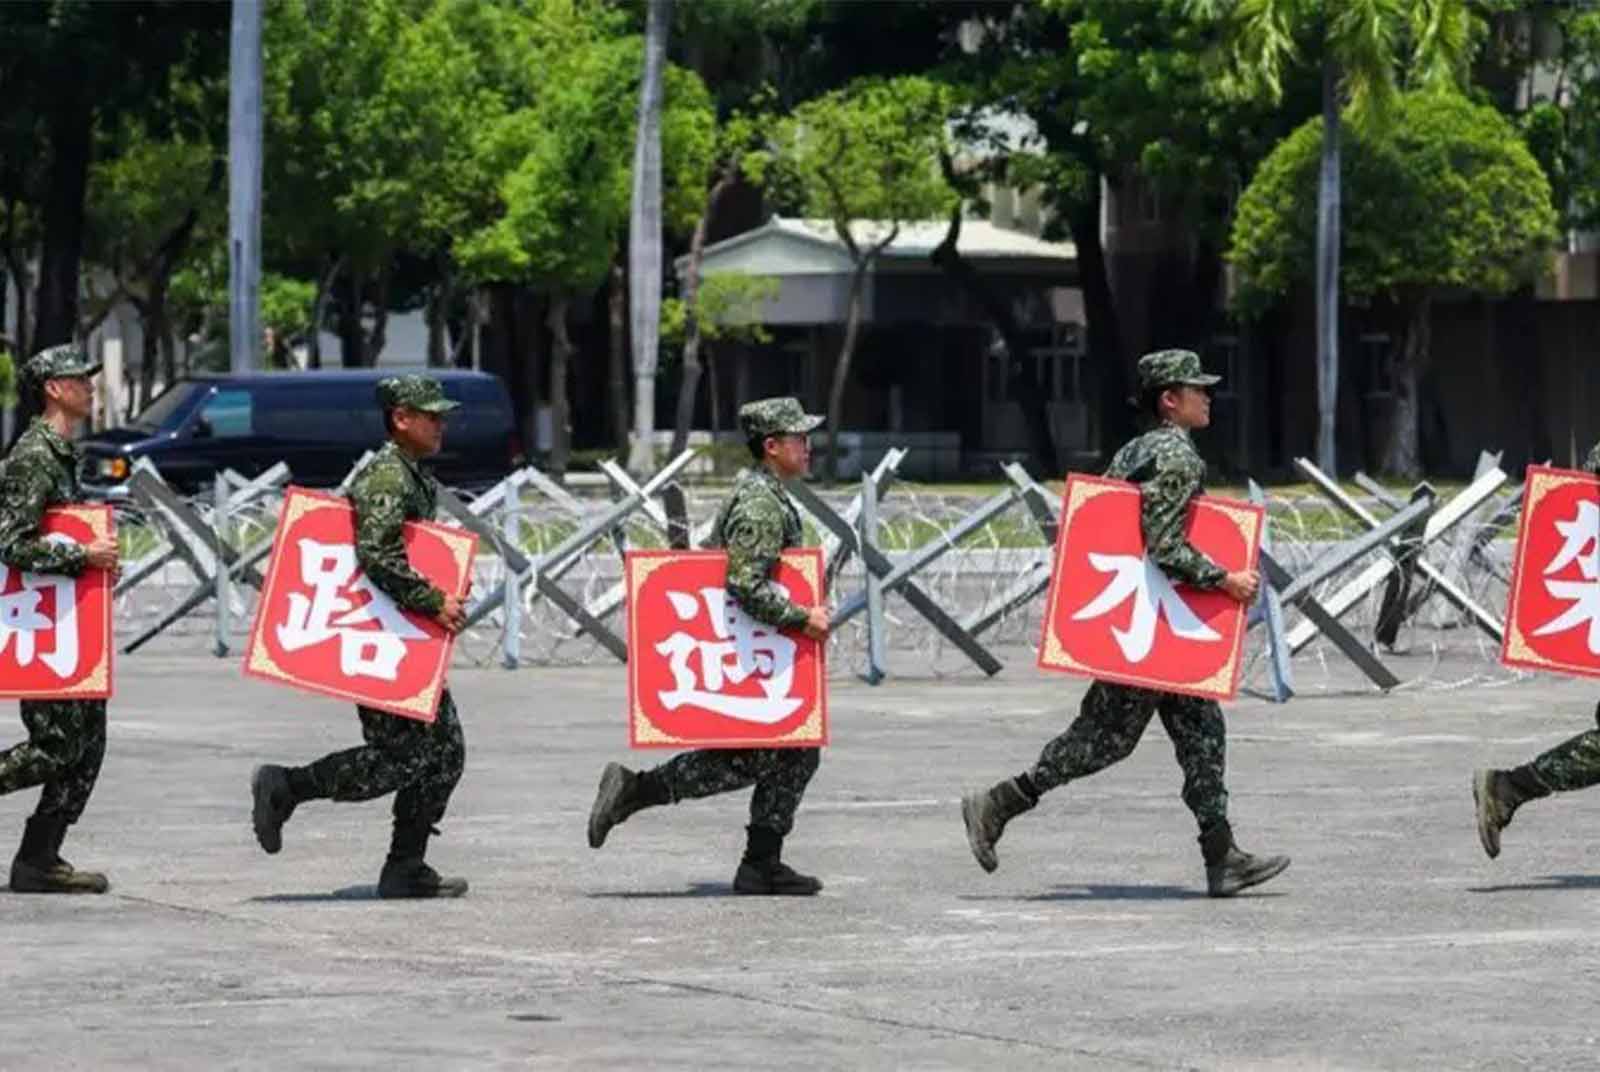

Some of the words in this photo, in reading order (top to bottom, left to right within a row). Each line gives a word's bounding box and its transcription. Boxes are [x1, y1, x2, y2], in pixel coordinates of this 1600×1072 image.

[276, 538, 431, 680] 路
[655, 581, 804, 724] 遇
[1071, 549, 1222, 663] 水
